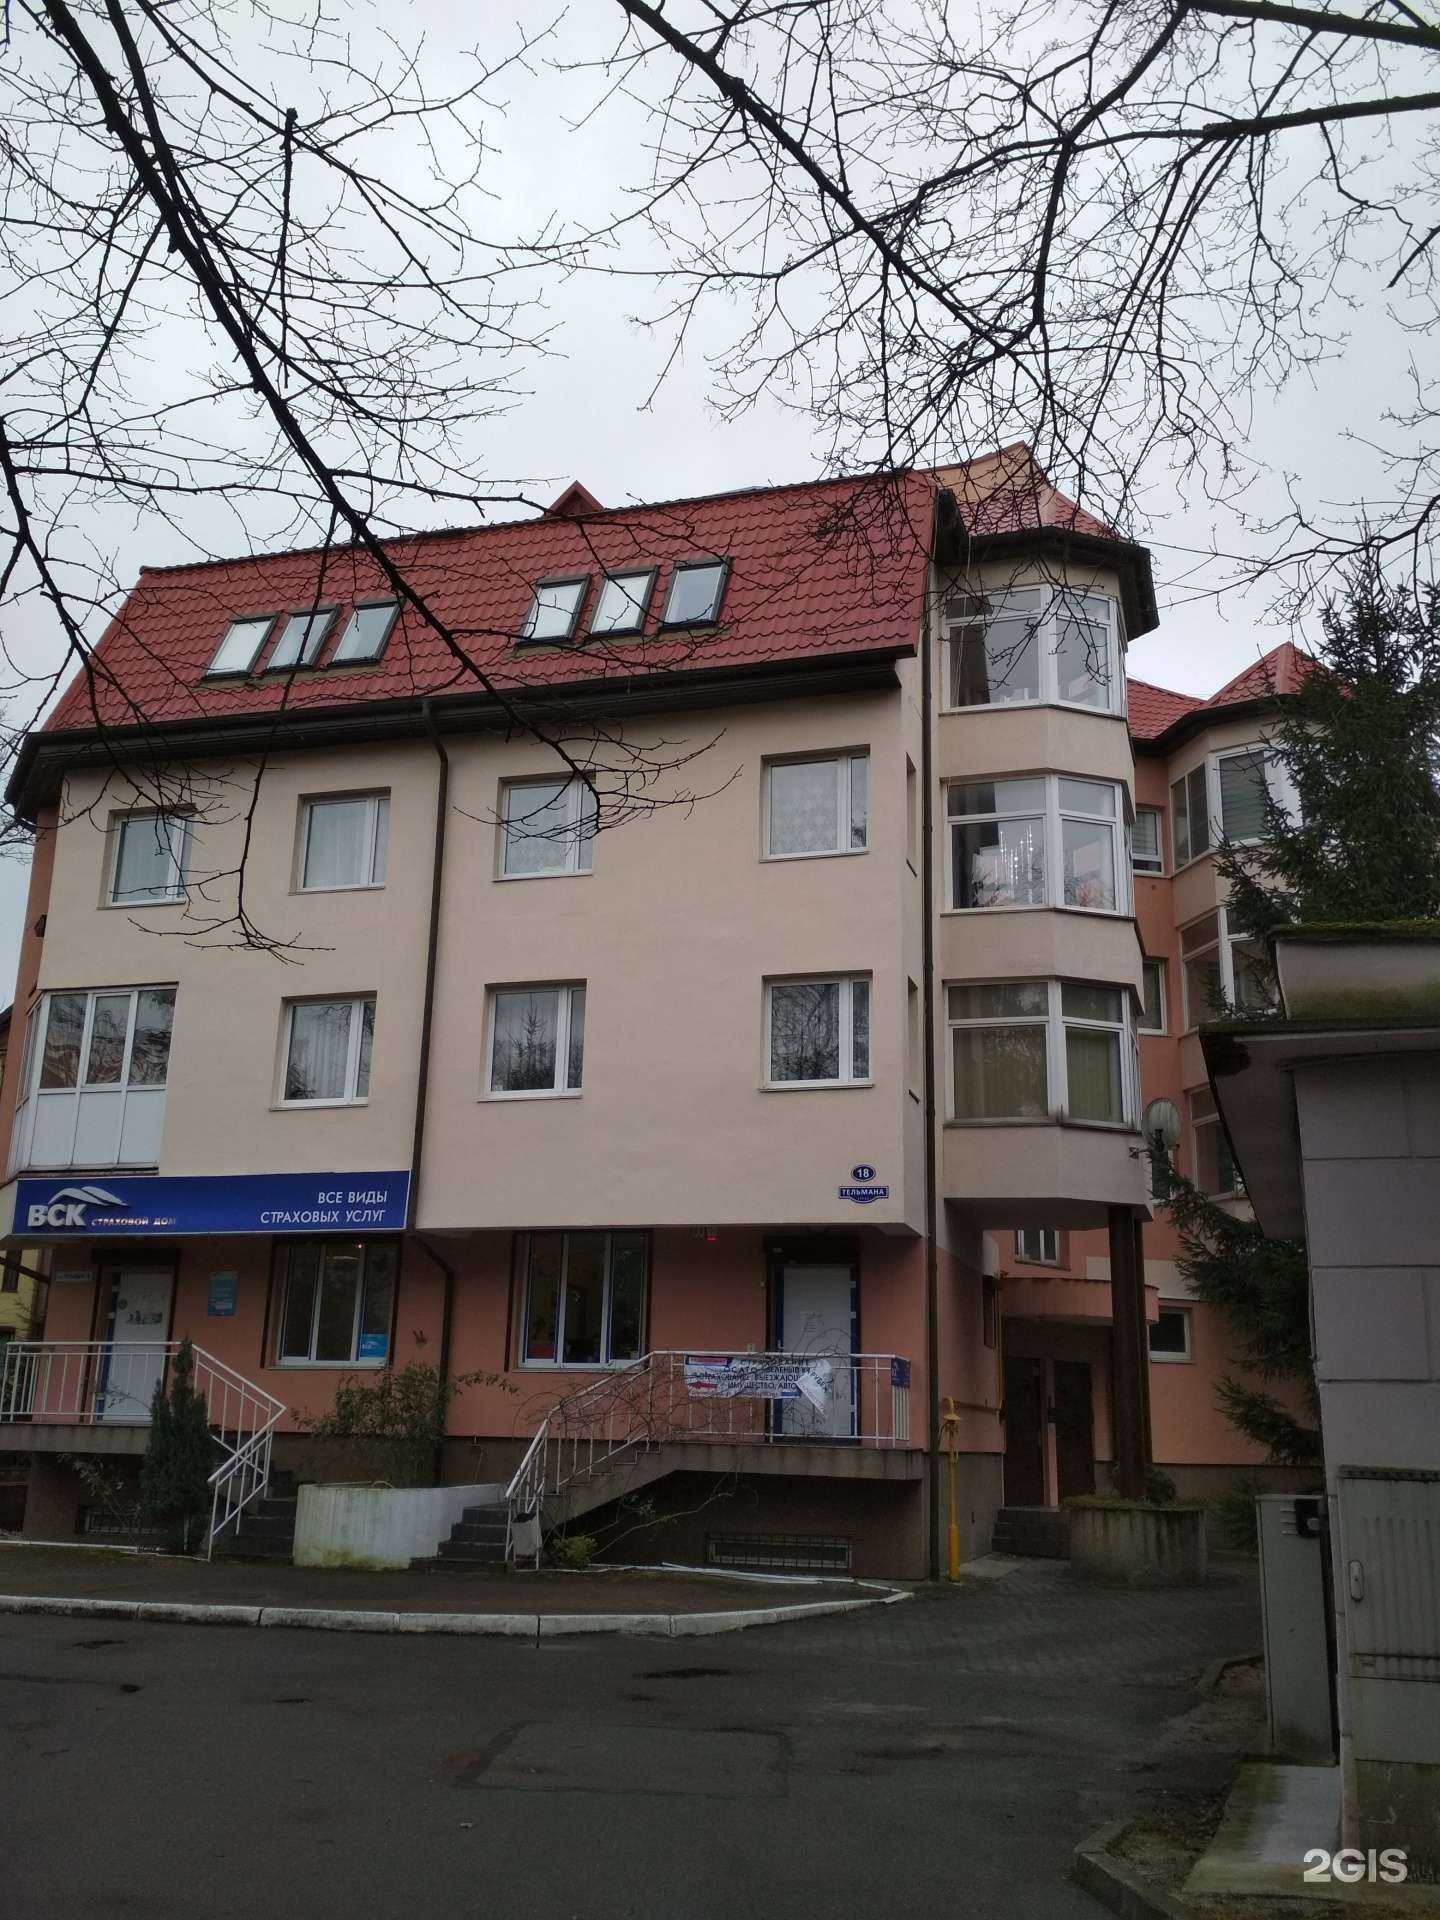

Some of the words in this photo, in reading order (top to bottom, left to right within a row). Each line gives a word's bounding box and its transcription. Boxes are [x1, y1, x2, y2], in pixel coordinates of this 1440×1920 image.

[857, 1168, 870, 1178] 18
[317, 1191, 343, 1204] ВСЕ
[347, 1190, 388, 1205] ВИДЫ
[841, 1188, 885, 1196] ТЕЛЬМАНА
[27, 1203, 87, 1227] ВСК
[91, 1216, 149, 1226] СТРАХОВОЙ
[153, 1217, 176, 1226] ДОМ
[260, 1210, 340, 1224] СТРАХОВЫХ
[345, 1209, 386, 1222] УСЛУГ
